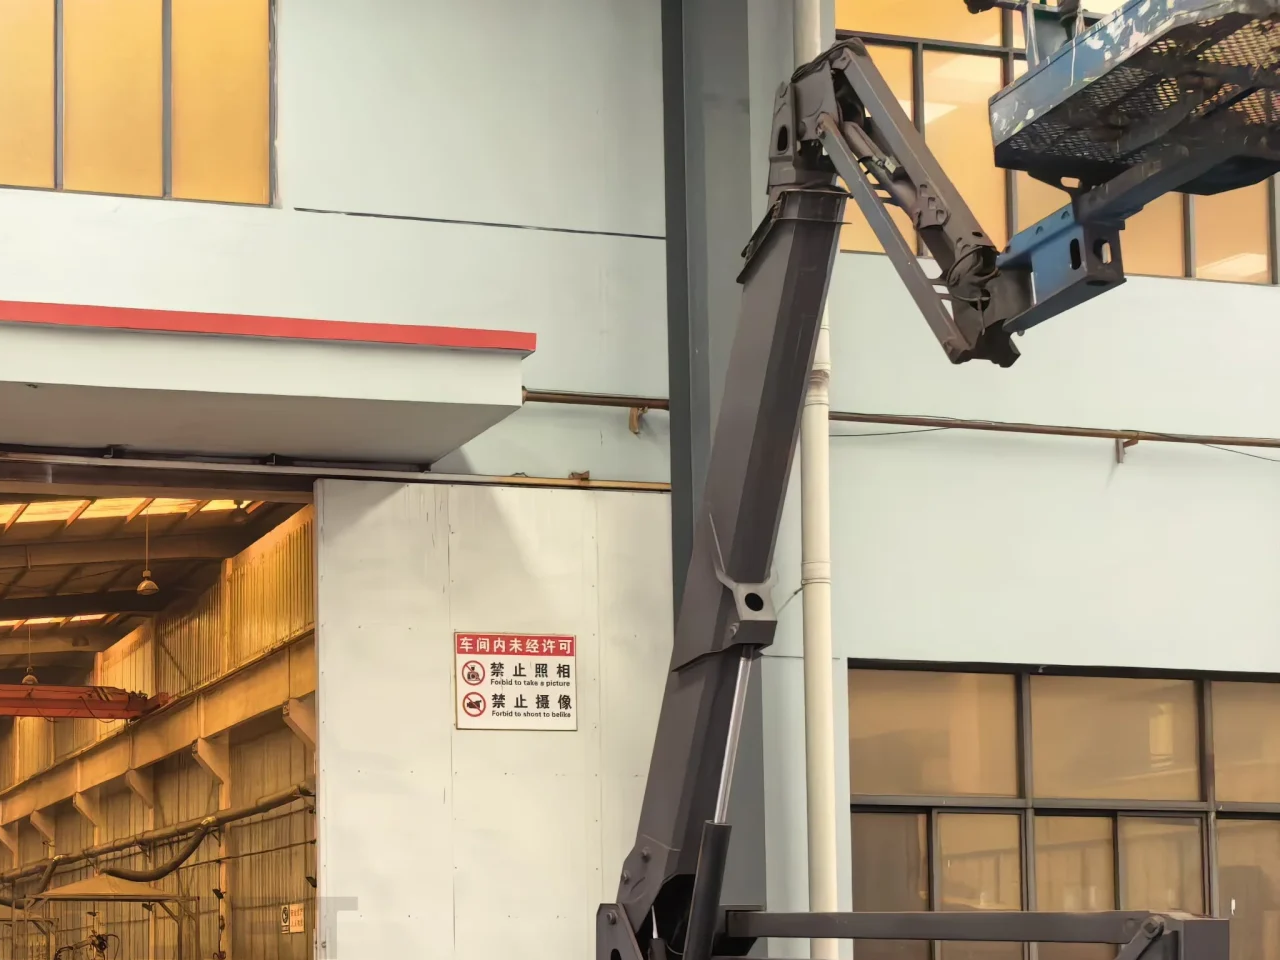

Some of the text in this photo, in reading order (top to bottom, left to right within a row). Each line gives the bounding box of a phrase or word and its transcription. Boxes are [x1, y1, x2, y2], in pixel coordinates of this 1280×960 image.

[459, 637, 572, 654] 车间内未经许可
[490, 661, 570, 679] 禁止照相
[523, 679, 538, 687] take
[491, 693, 572, 710] 禁止摄像
